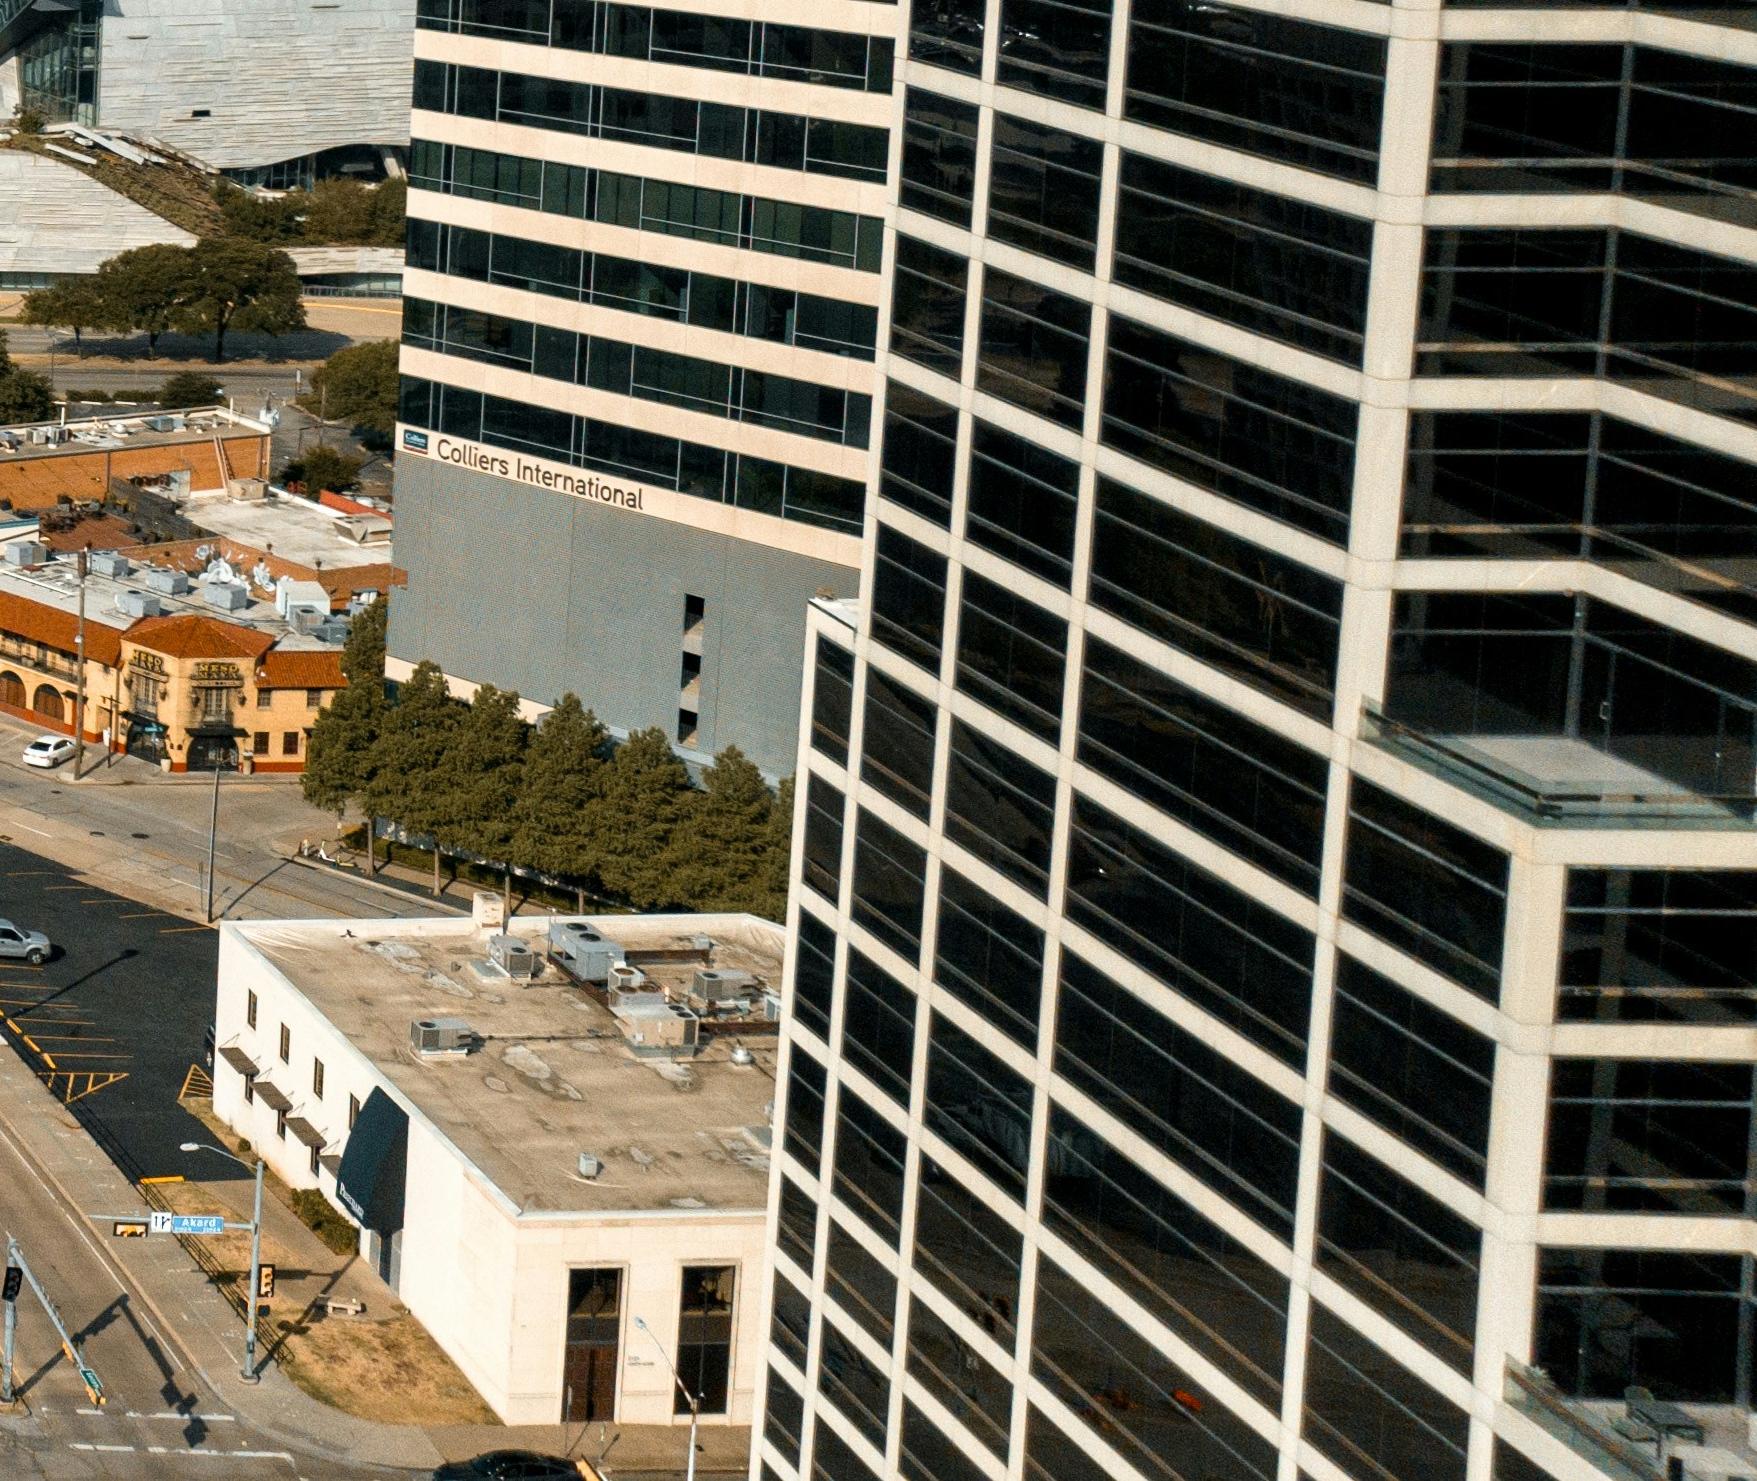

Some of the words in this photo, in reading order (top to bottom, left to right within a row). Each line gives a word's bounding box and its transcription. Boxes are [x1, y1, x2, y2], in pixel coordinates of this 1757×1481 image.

[437, 438, 509, 476] Colliers
[516, 457, 643, 510] International
[198, 663, 239, 672] MESO
[181, 1218, 216, 1228] Akard
